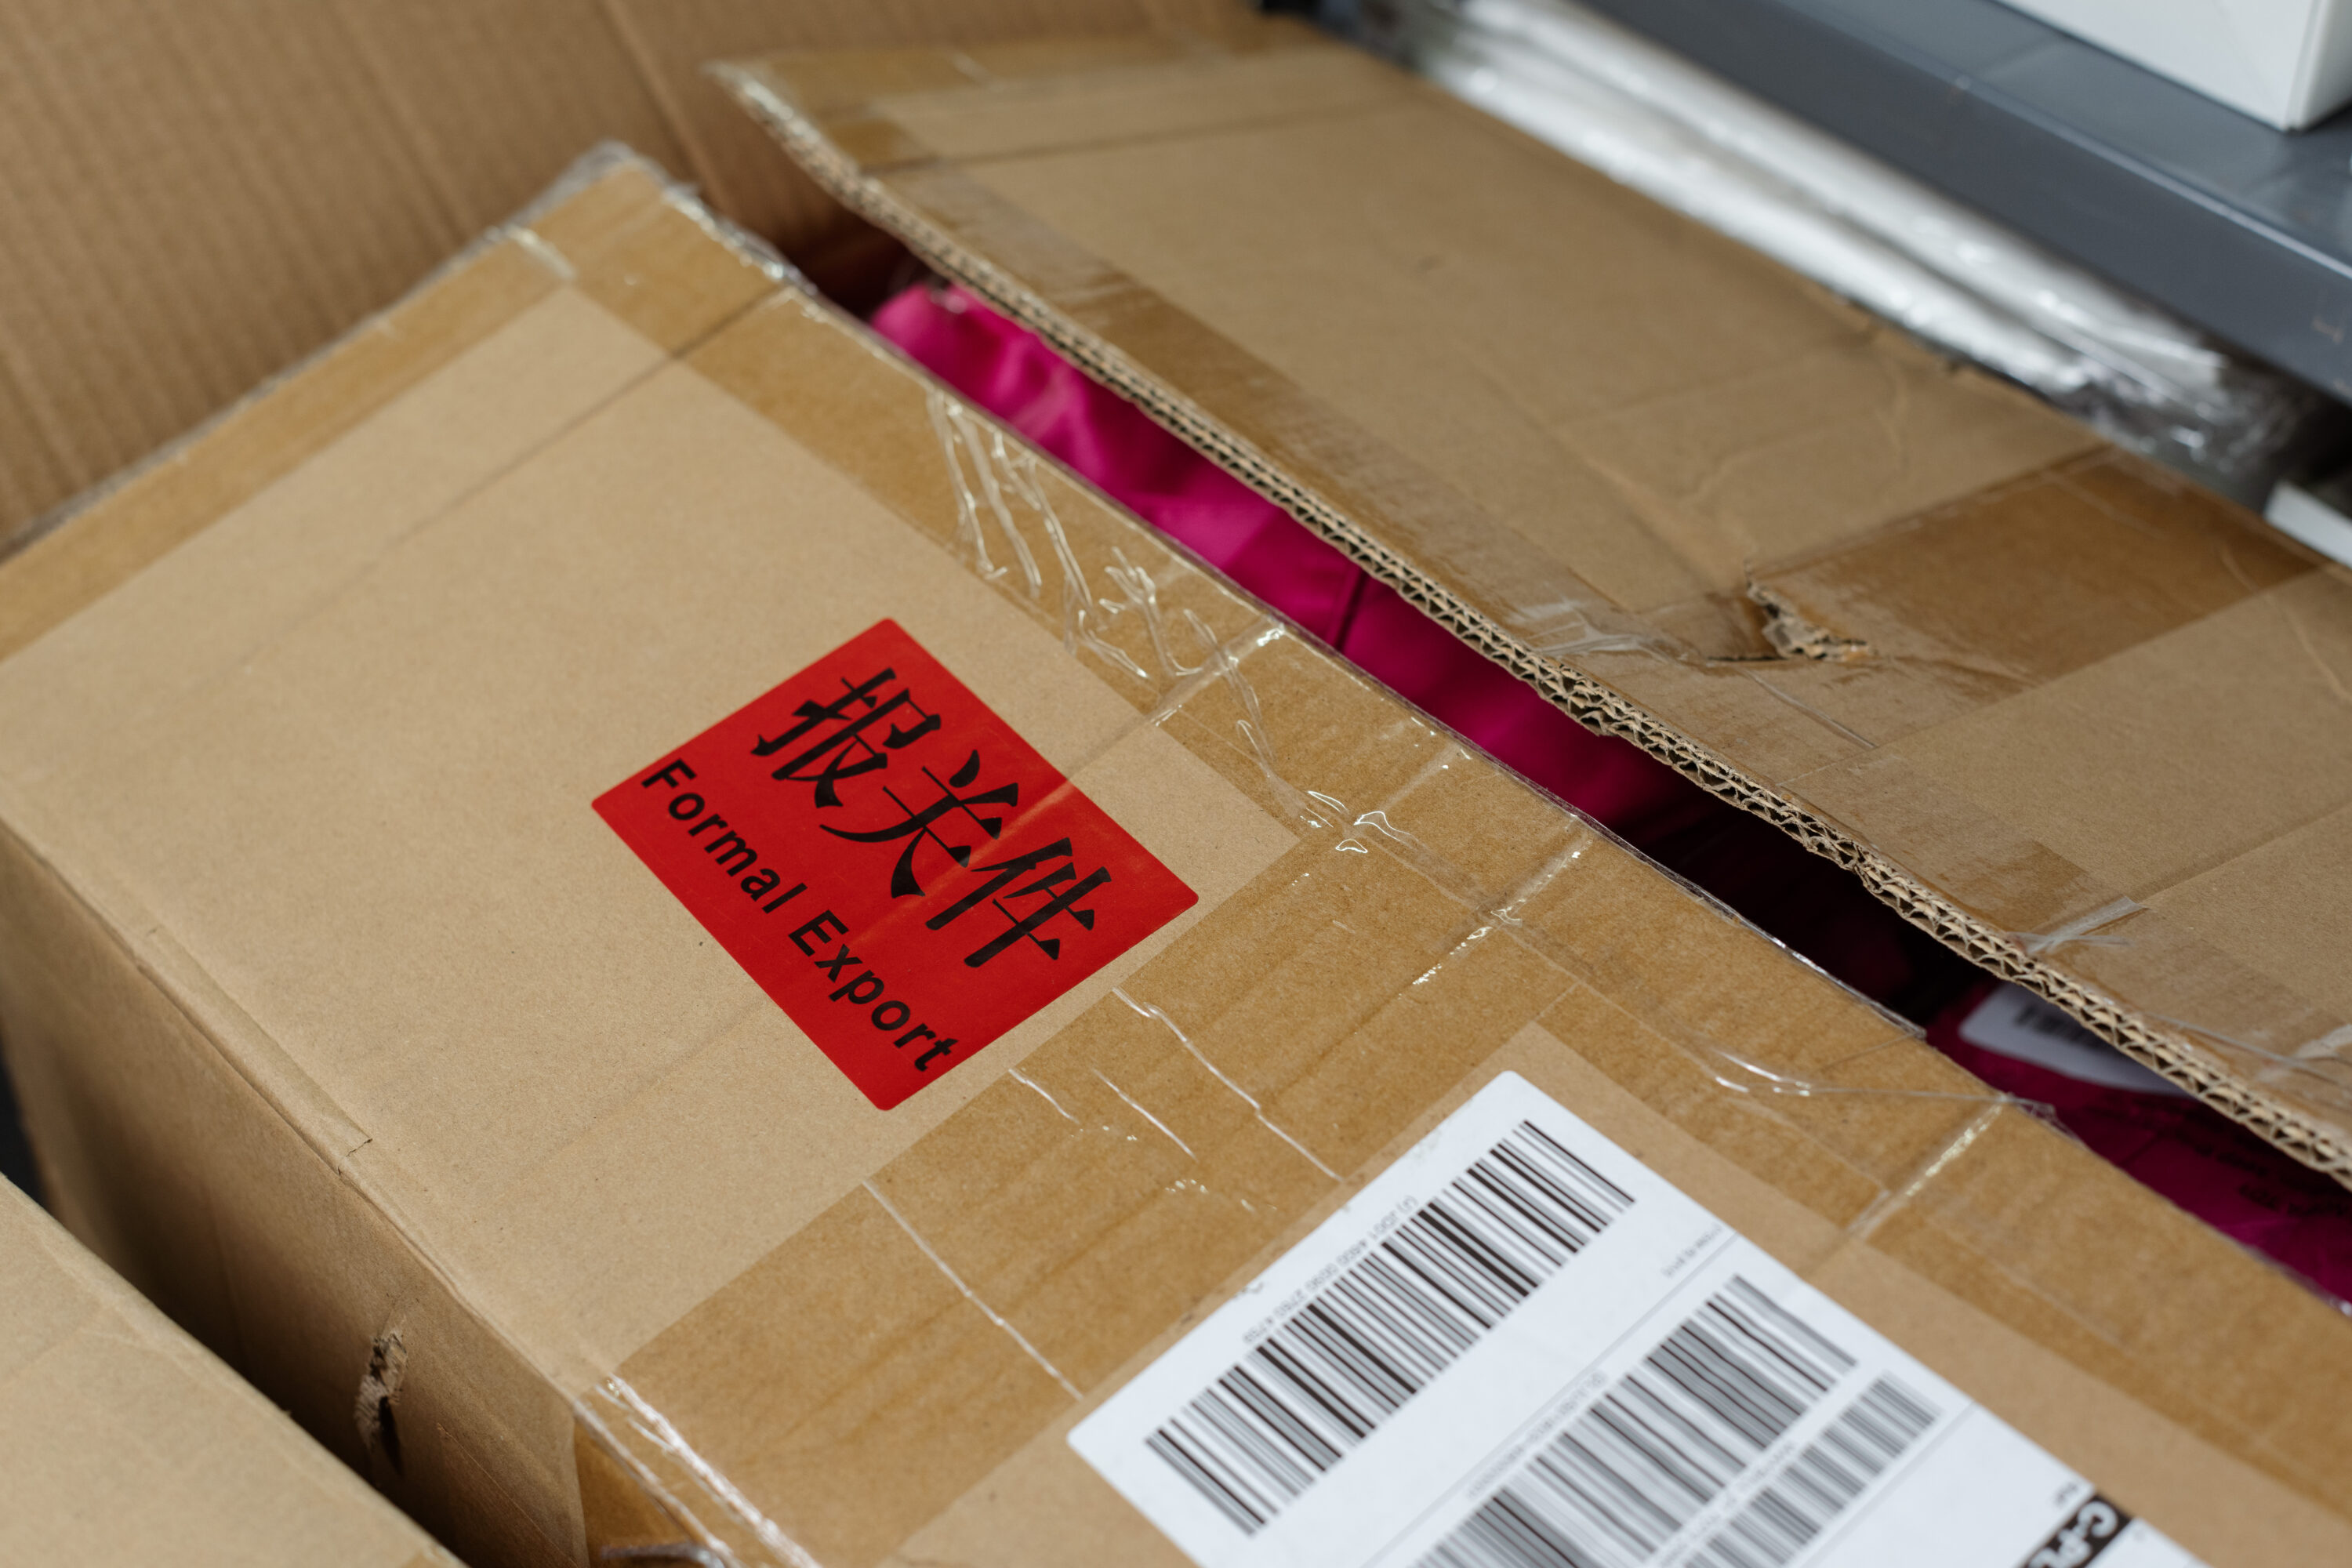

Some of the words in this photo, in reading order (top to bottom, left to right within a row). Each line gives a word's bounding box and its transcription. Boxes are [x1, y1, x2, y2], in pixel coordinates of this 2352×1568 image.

[642, 760, 808, 913] Formal
[789, 909, 957, 1071] Export
[751, 668, 1111, 967] 报关件
